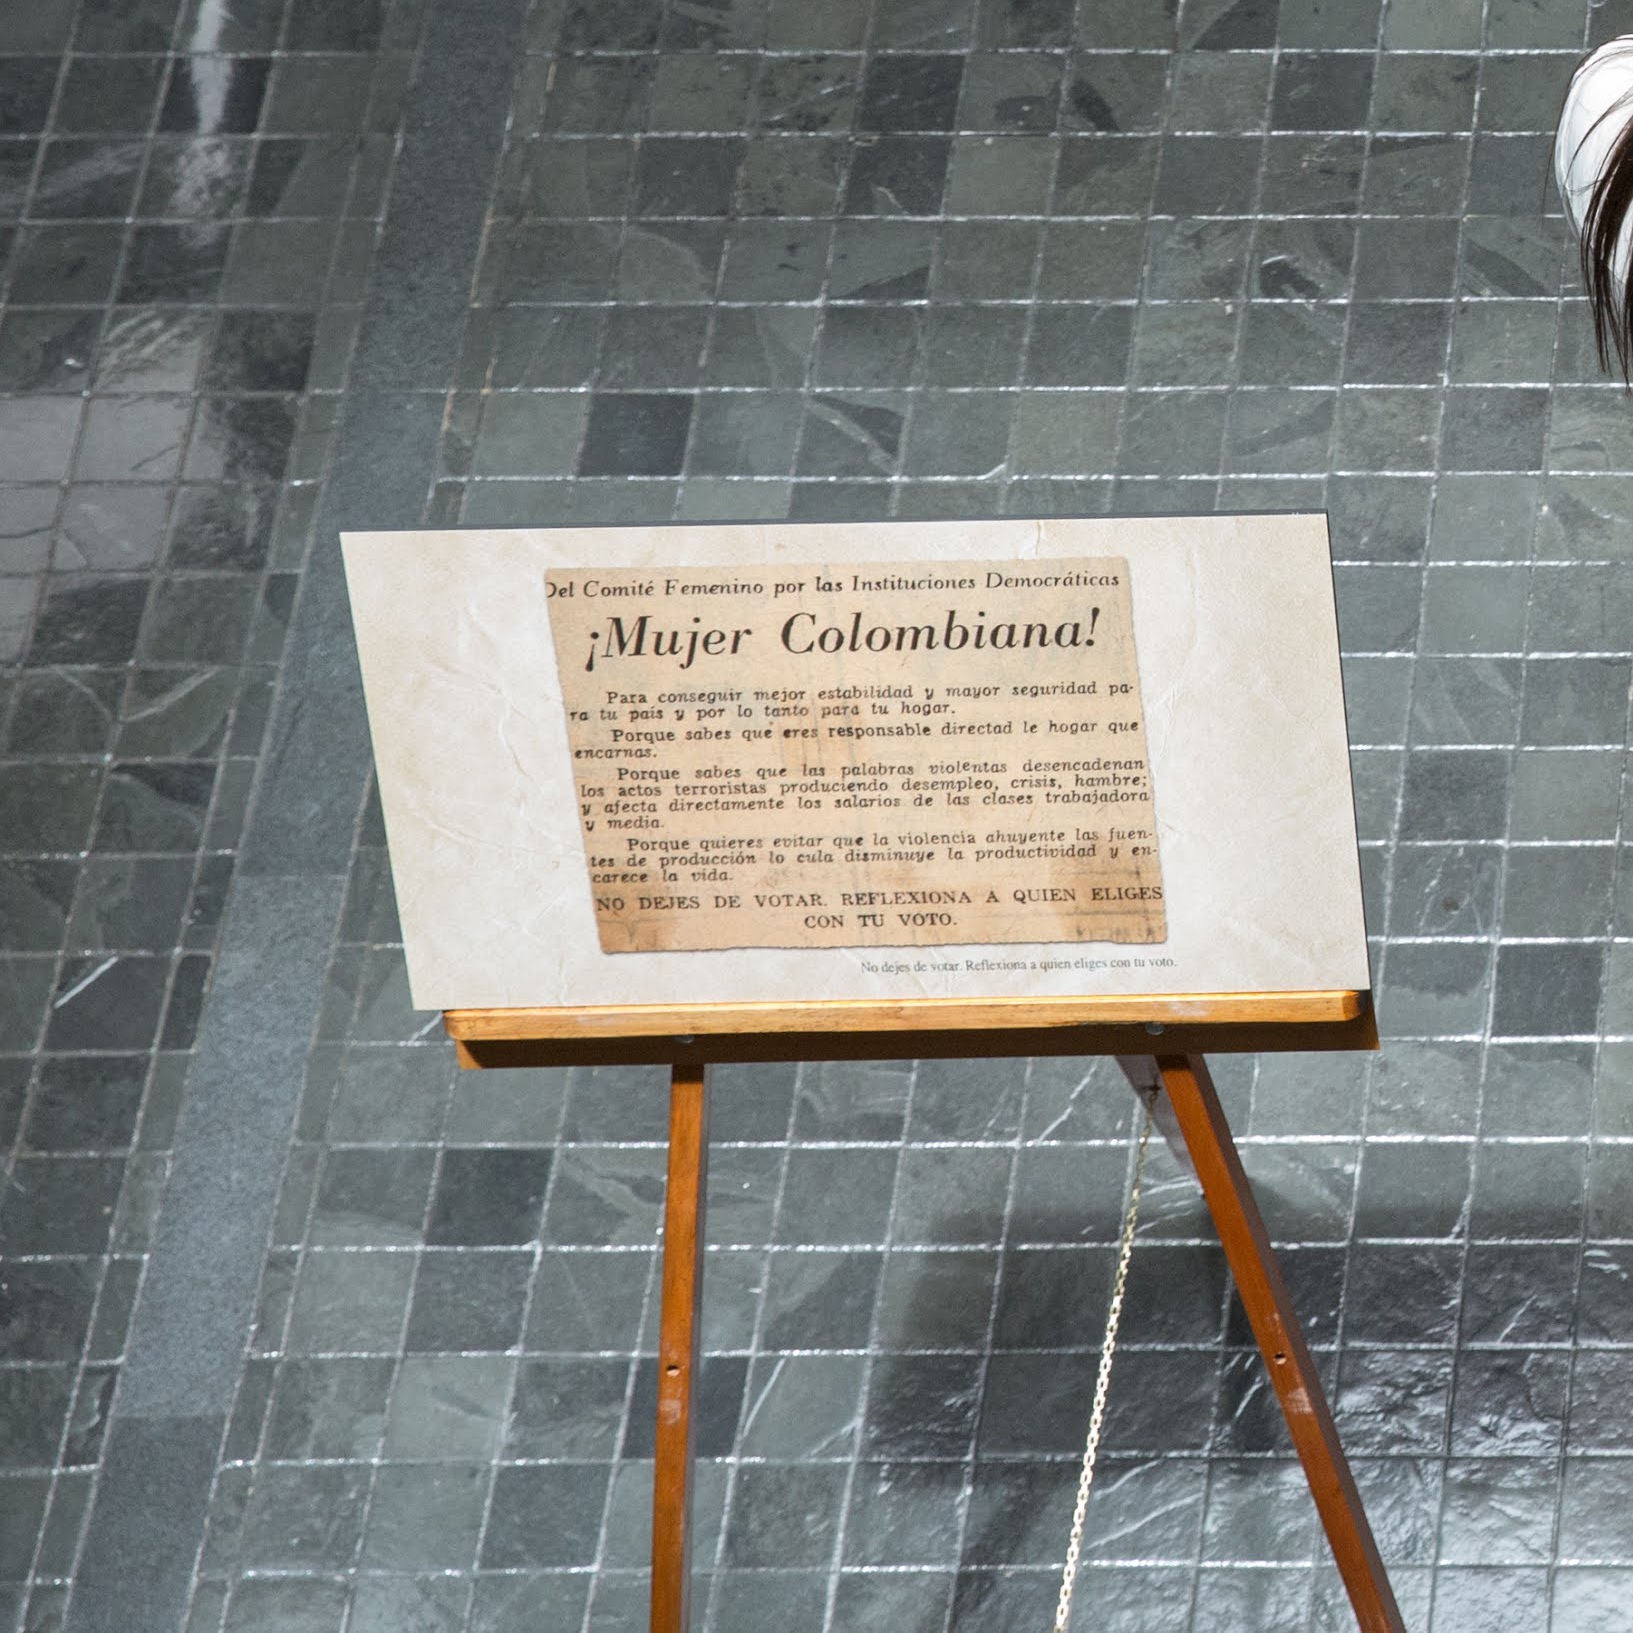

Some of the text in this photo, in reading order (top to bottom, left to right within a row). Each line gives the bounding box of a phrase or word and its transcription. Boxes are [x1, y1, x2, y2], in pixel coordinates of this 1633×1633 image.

[584, 580, 654, 597] Comité
[665, 578, 763, 596] Femenino
[774, 580, 805, 598] por
[816, 576, 842, 593] las
[852, 573, 975, 591] Instituciones
[986, 571, 1120, 589] Democráticas
[585, 606, 1100, 672] ¡Mujer Colombiana!
[606, 681, 1134, 705] Para conseguir mejor estabilidad y mayor seguridad pa-
[570, 700, 956, 722] ra tu país y por lo tanto para tu hogar.
[611, 728, 676, 744] Porque
[685, 726, 731, 741] sabes
[783, 727, 818, 740] eres
[828, 723, 931, 739] responsable
[941, 721, 1012, 735] directad
[1023, 720, 1037, 734] le
[1048, 719, 1098, 735] hogar
[1108, 720, 1139, 734] que
[575, 748, 658, 759] encarnas.
[617, 757, 1144, 782] Porque sabes que las palabras violentas desencadenan
[581, 773, 1147, 797] los actos terroristas produciendo desempleo, crisis, hambre;
[582, 789, 1150, 816] y afecta directamente los salarios de las clases trabajadora
[607, 817, 664, 830] media.
[627, 826, 1153, 852] Porque quieres evitar que la violencia ahuyente las fuen-
[591, 843, 1158, 869] tes de producción lo cula disminuye la productividad y en-
[592, 868, 733, 884] carece la vida.
[597, 886, 1162, 911] NO DEJES DE VOTAR. REFLEXIONA A QUIEN ELIGES
[804, 912, 957, 929] CON TU VOTO.
[861, 957, 1178, 976] No dejes de votar. Reflexiona a quien eliges con tu voto.
